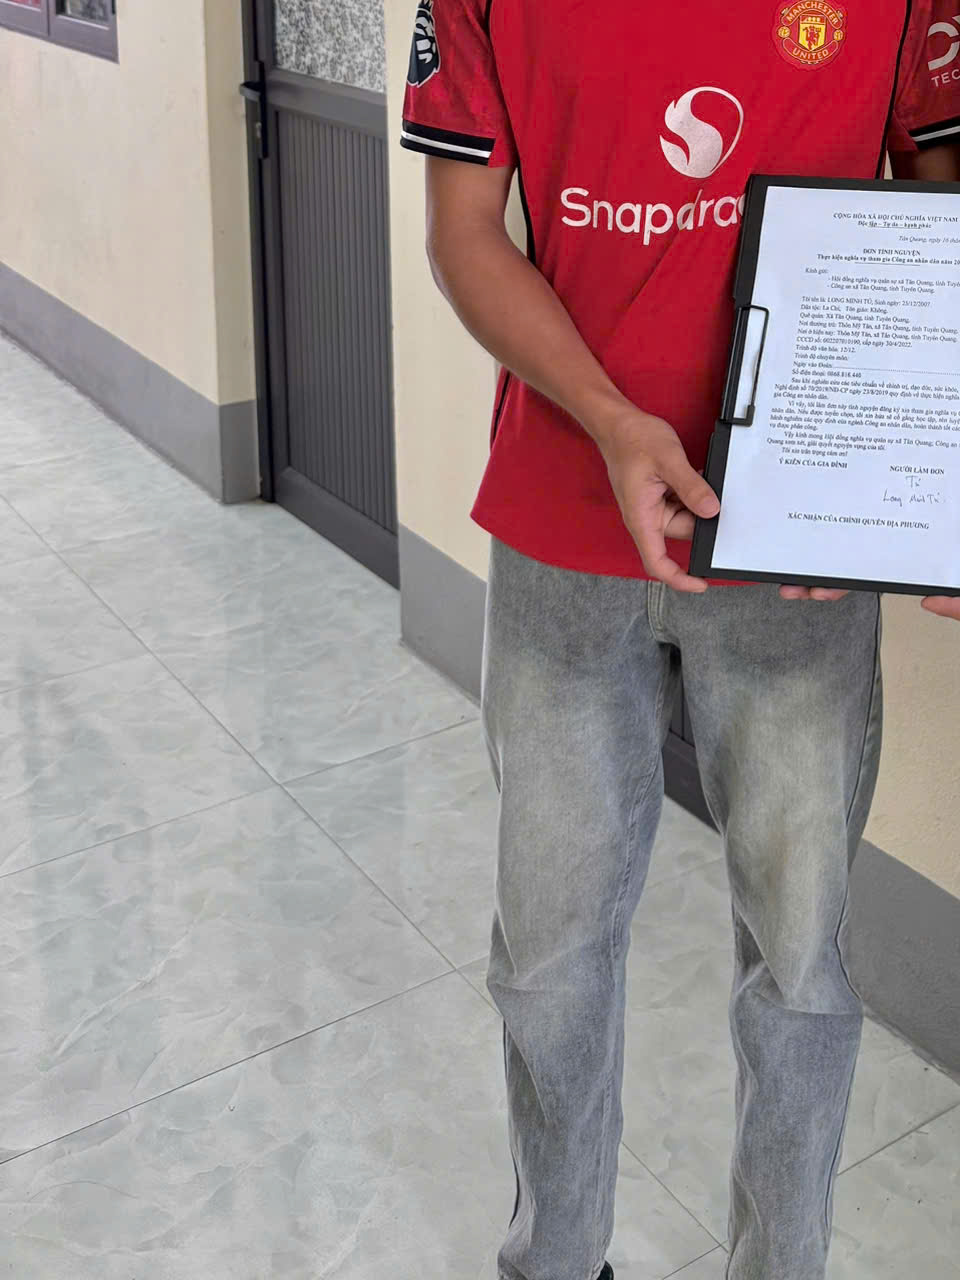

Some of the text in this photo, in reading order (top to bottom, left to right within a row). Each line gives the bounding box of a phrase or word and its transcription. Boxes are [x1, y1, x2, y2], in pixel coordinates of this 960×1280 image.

[786, 0, 838, 25] MANCHESTER
[792, 47, 829, 61] UNITED
[803, 513, 822, 522] NHẬN
[838, 515, 861, 523] CHÍNH
[862, 517, 885, 526] QUYỀN
